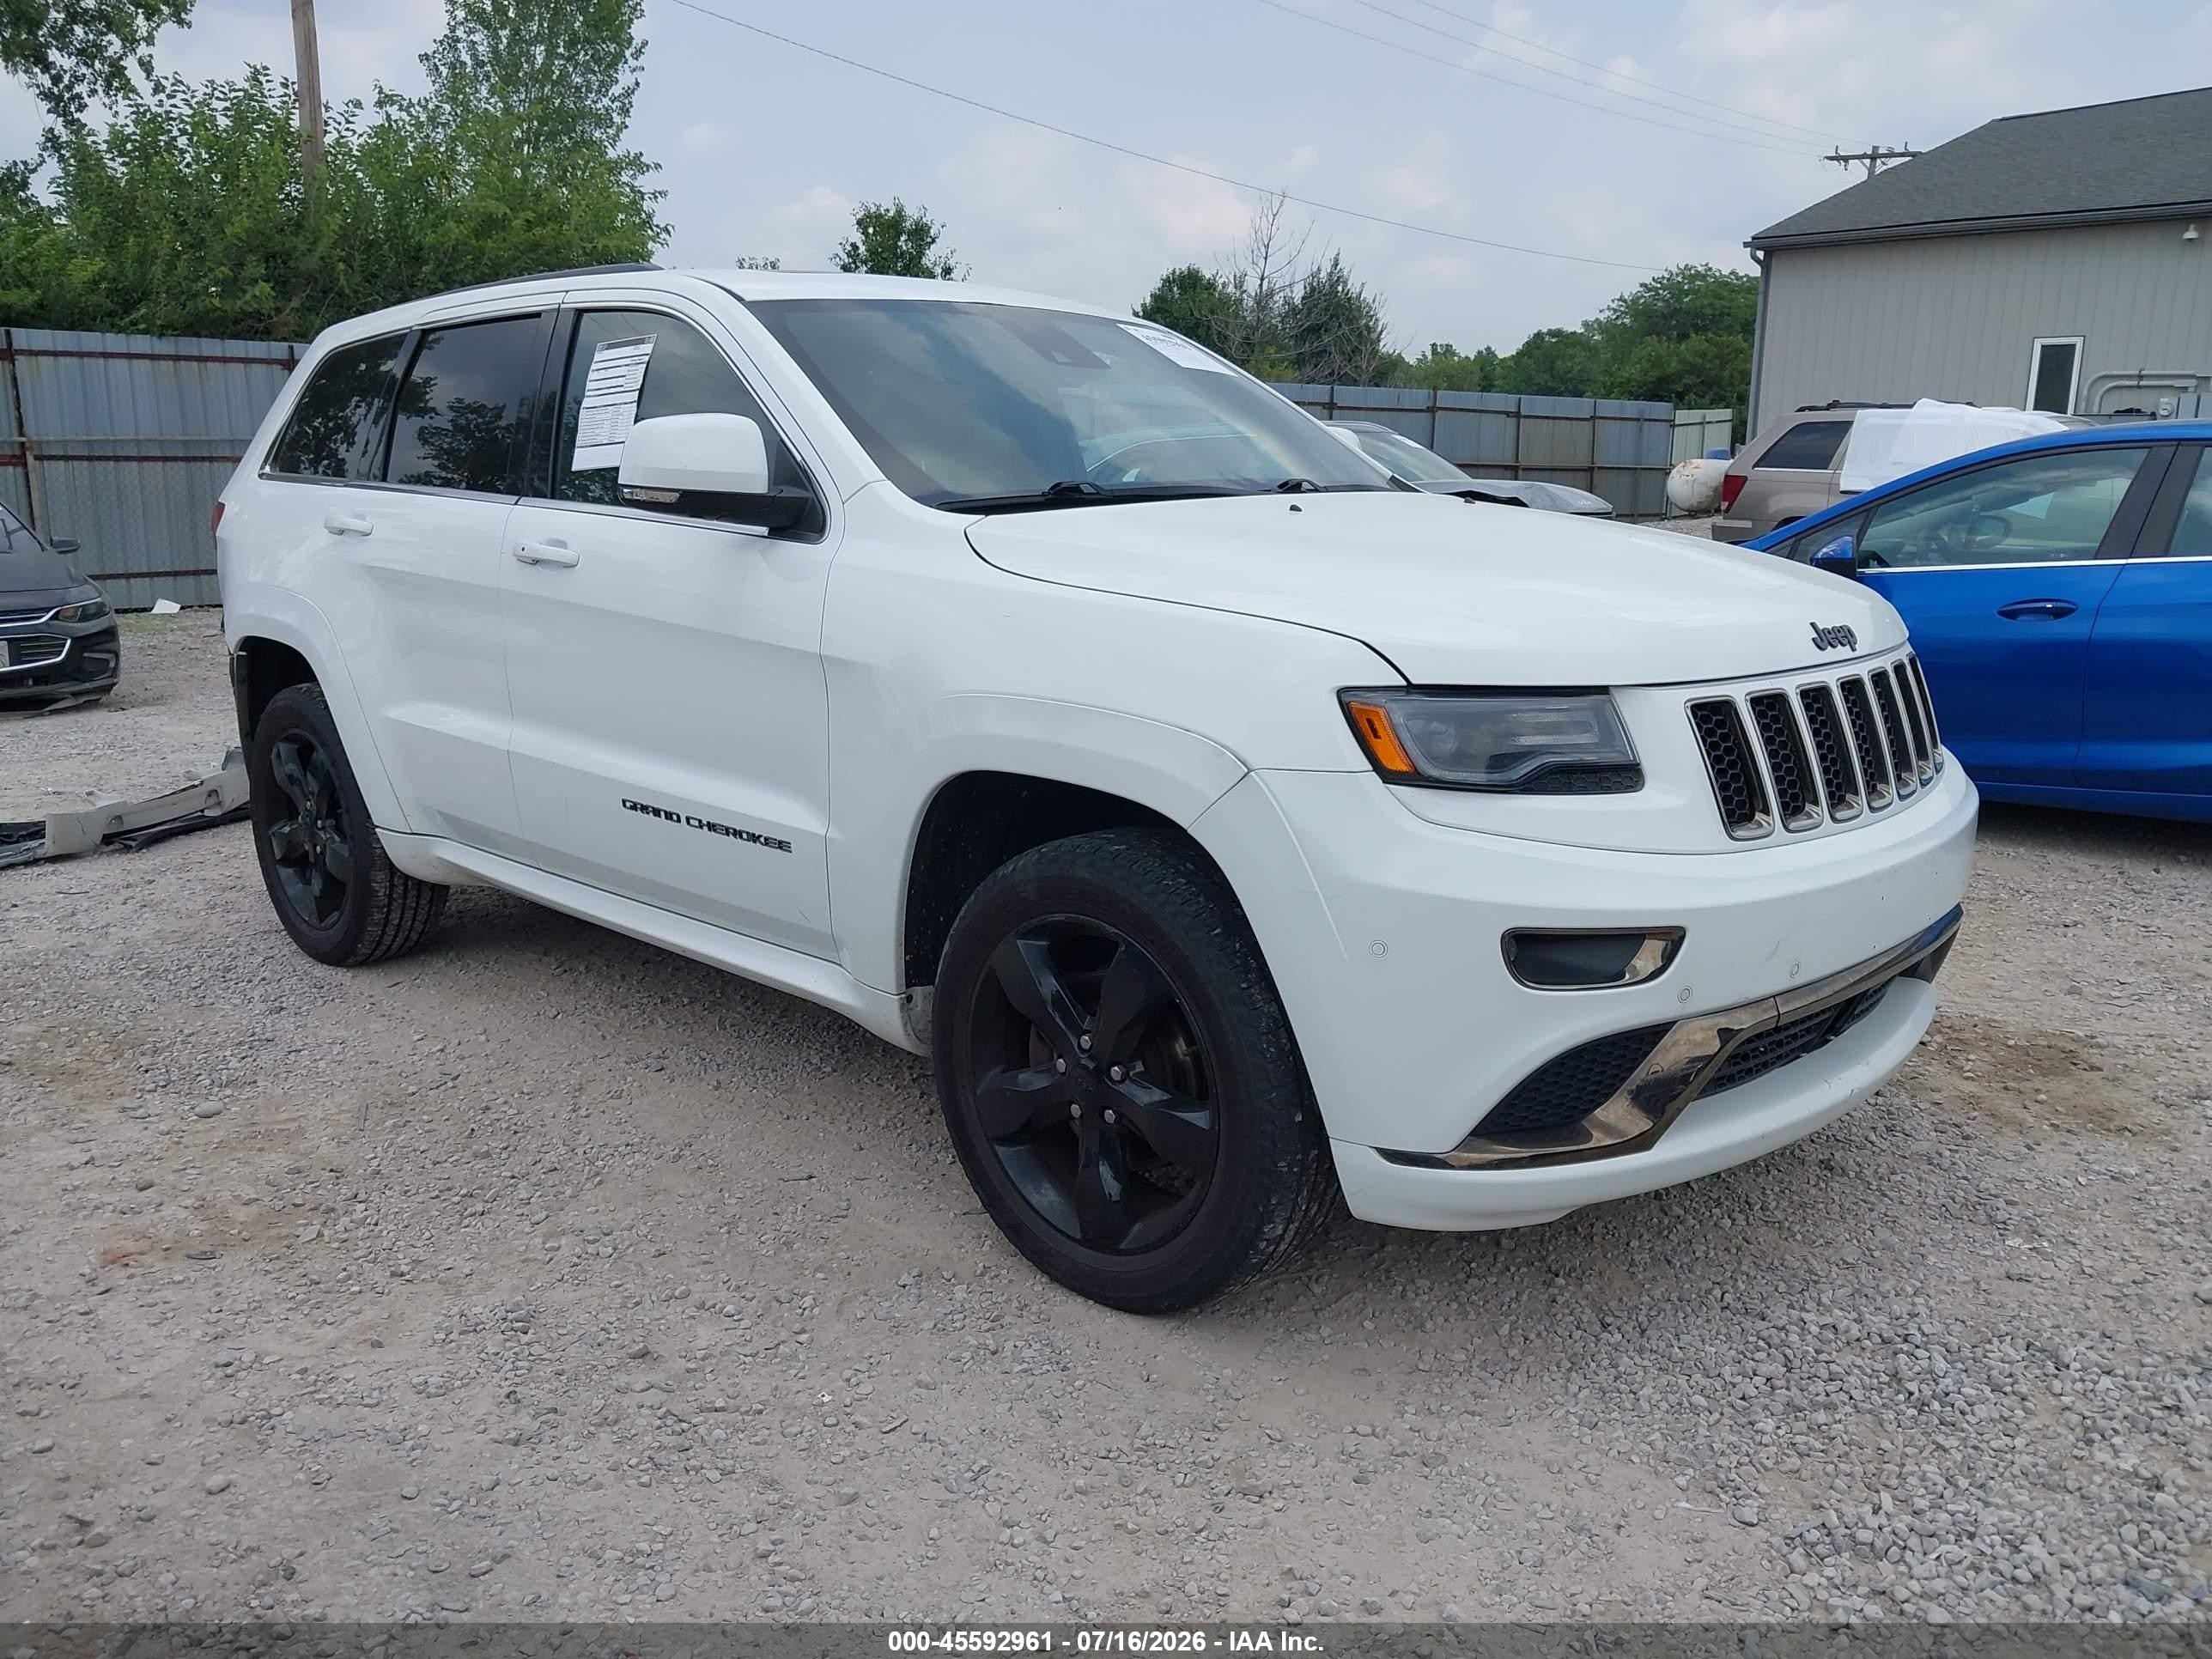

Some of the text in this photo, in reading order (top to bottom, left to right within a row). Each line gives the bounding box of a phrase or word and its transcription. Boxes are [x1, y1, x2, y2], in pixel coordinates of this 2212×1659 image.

[1809, 622, 1858, 653] Jeep
[621, 798, 793, 854] GRAND CHEROKEE
